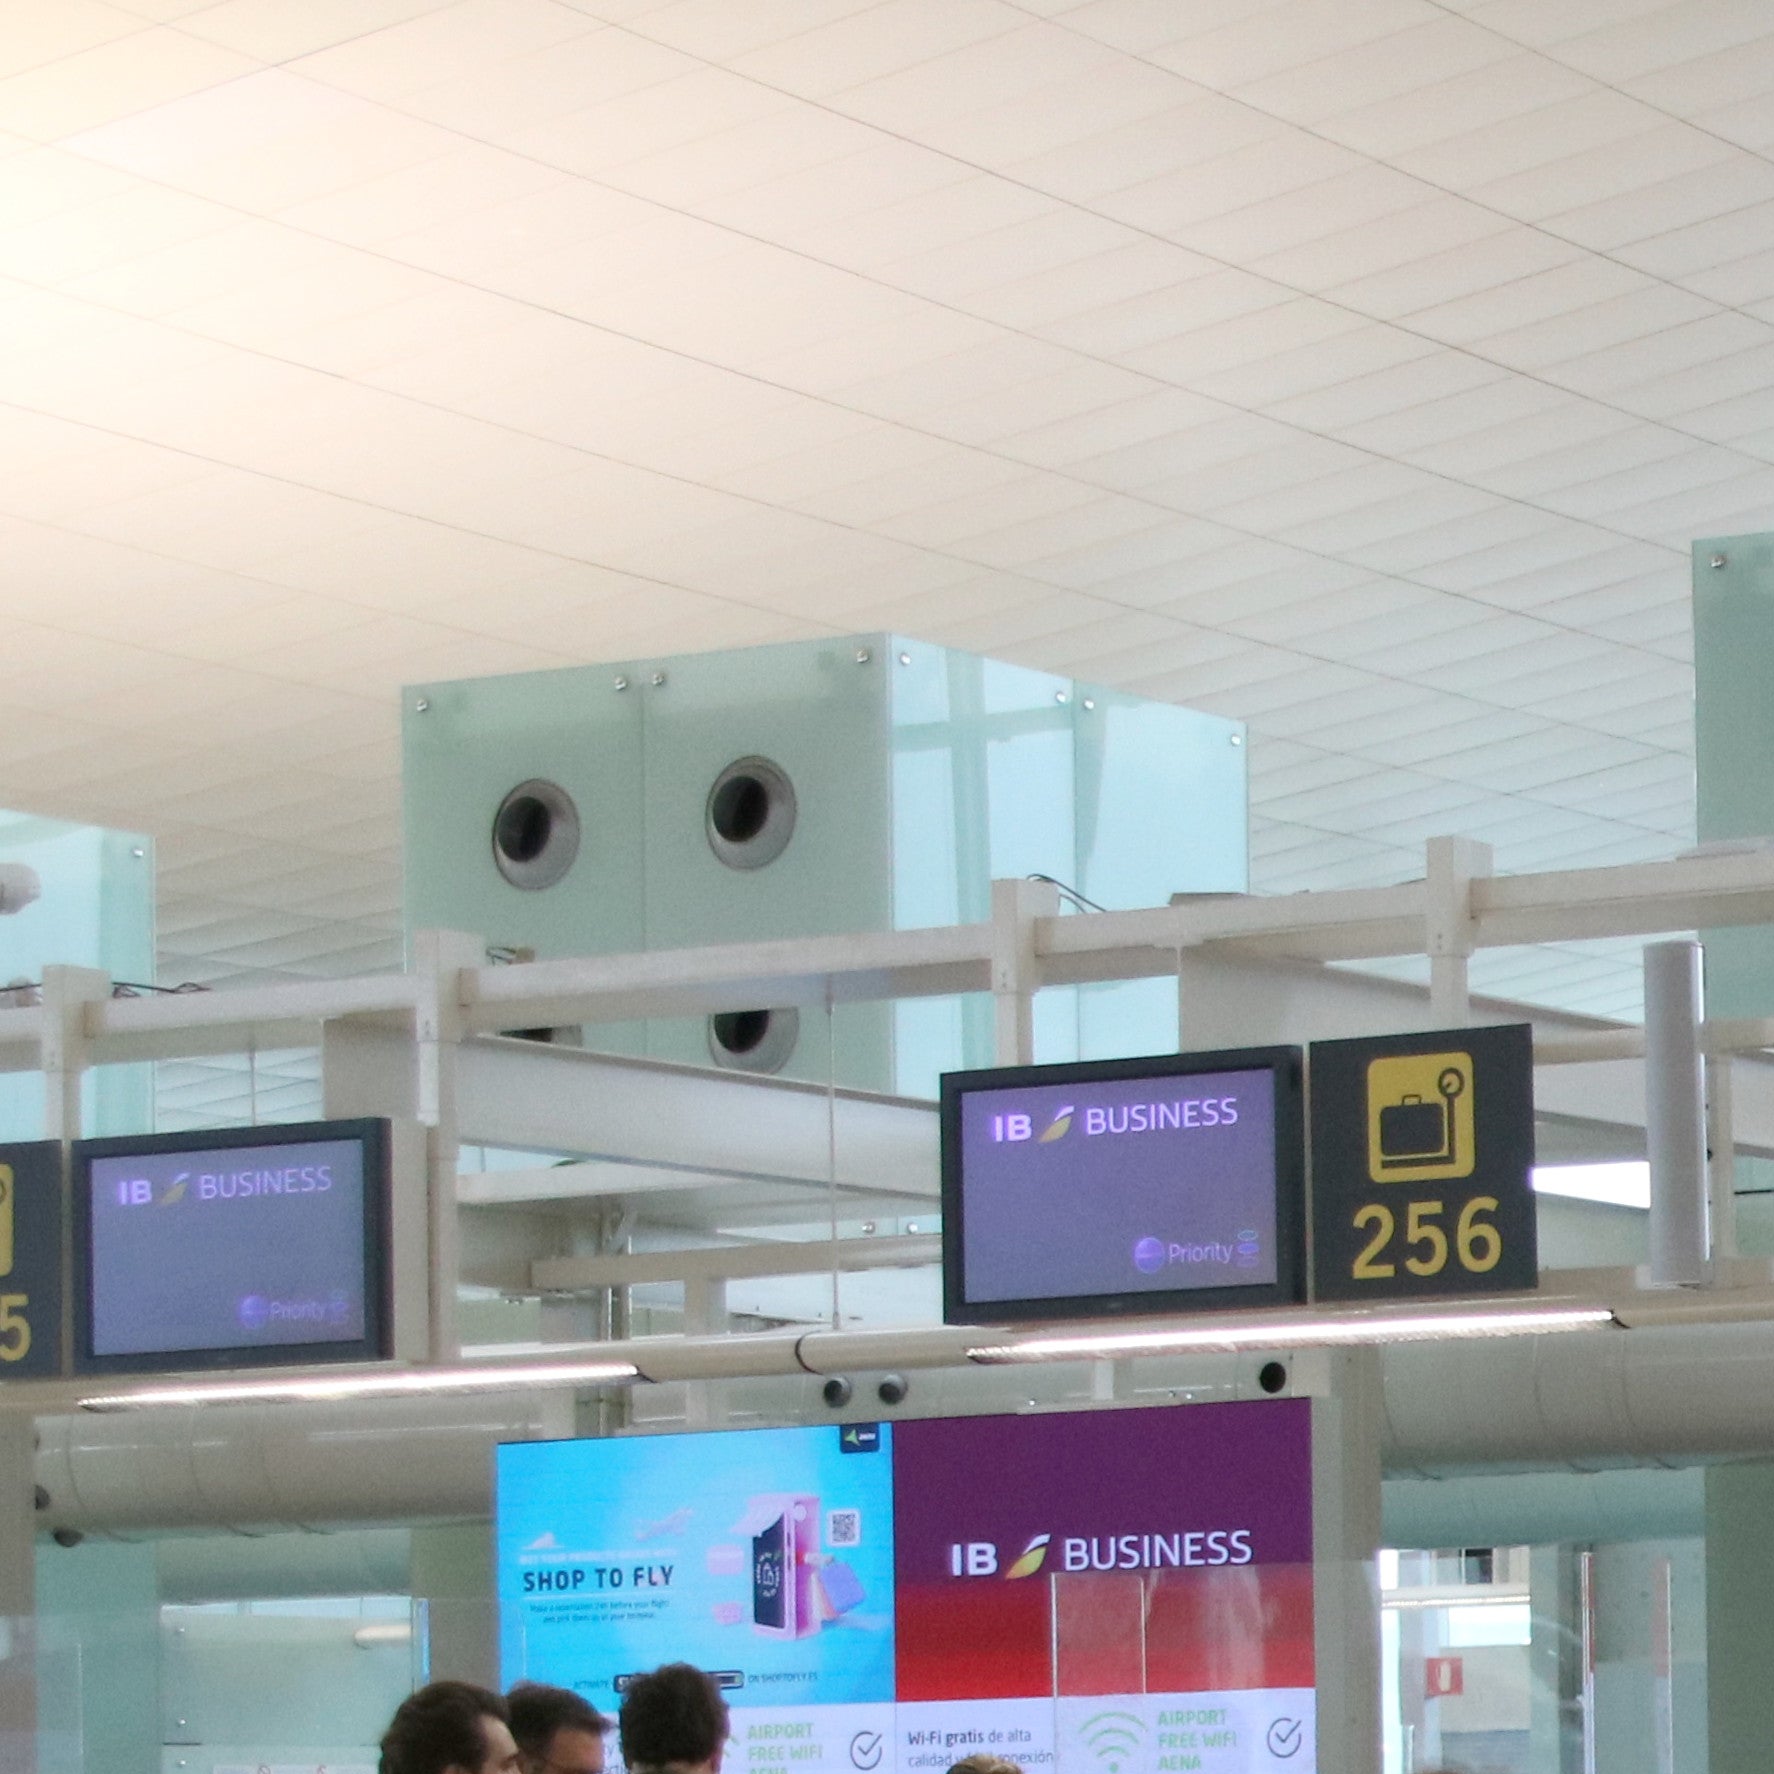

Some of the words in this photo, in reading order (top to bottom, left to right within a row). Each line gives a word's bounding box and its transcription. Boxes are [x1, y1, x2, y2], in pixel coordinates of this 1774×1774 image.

[994, 1114, 1032, 1142] IB
[1086, 1098, 1238, 1136] BUSINESS
[119, 1180, 152, 1205] IB
[200, 1167, 331, 1200] BUSINESS
[1352, 1197, 1501, 1280] 256
[1168, 1240, 1234, 1266] Priority
[951, 1542, 997, 1576] IB
[1064, 1530, 1253, 1571] BUSINESS
[523, 1569, 585, 1592] SHOP
[595, 1567, 623, 1588] TO
[633, 1565, 674, 1587] FLY
[1157, 1709, 1228, 1726] AIRPORT
[748, 1722, 815, 1740] AIRPORT
[908, 1731, 942, 1745] Wi-Fi
[946, 1730, 984, 1747] gratis
[988, 1729, 1004, 1743] de
[1007, 1728, 1032, 1742] alta
[1157, 1733, 1198, 1748] FREE
[748, 1744, 787, 1761] FREE
[1157, 1755, 1201, 1771] AENA
